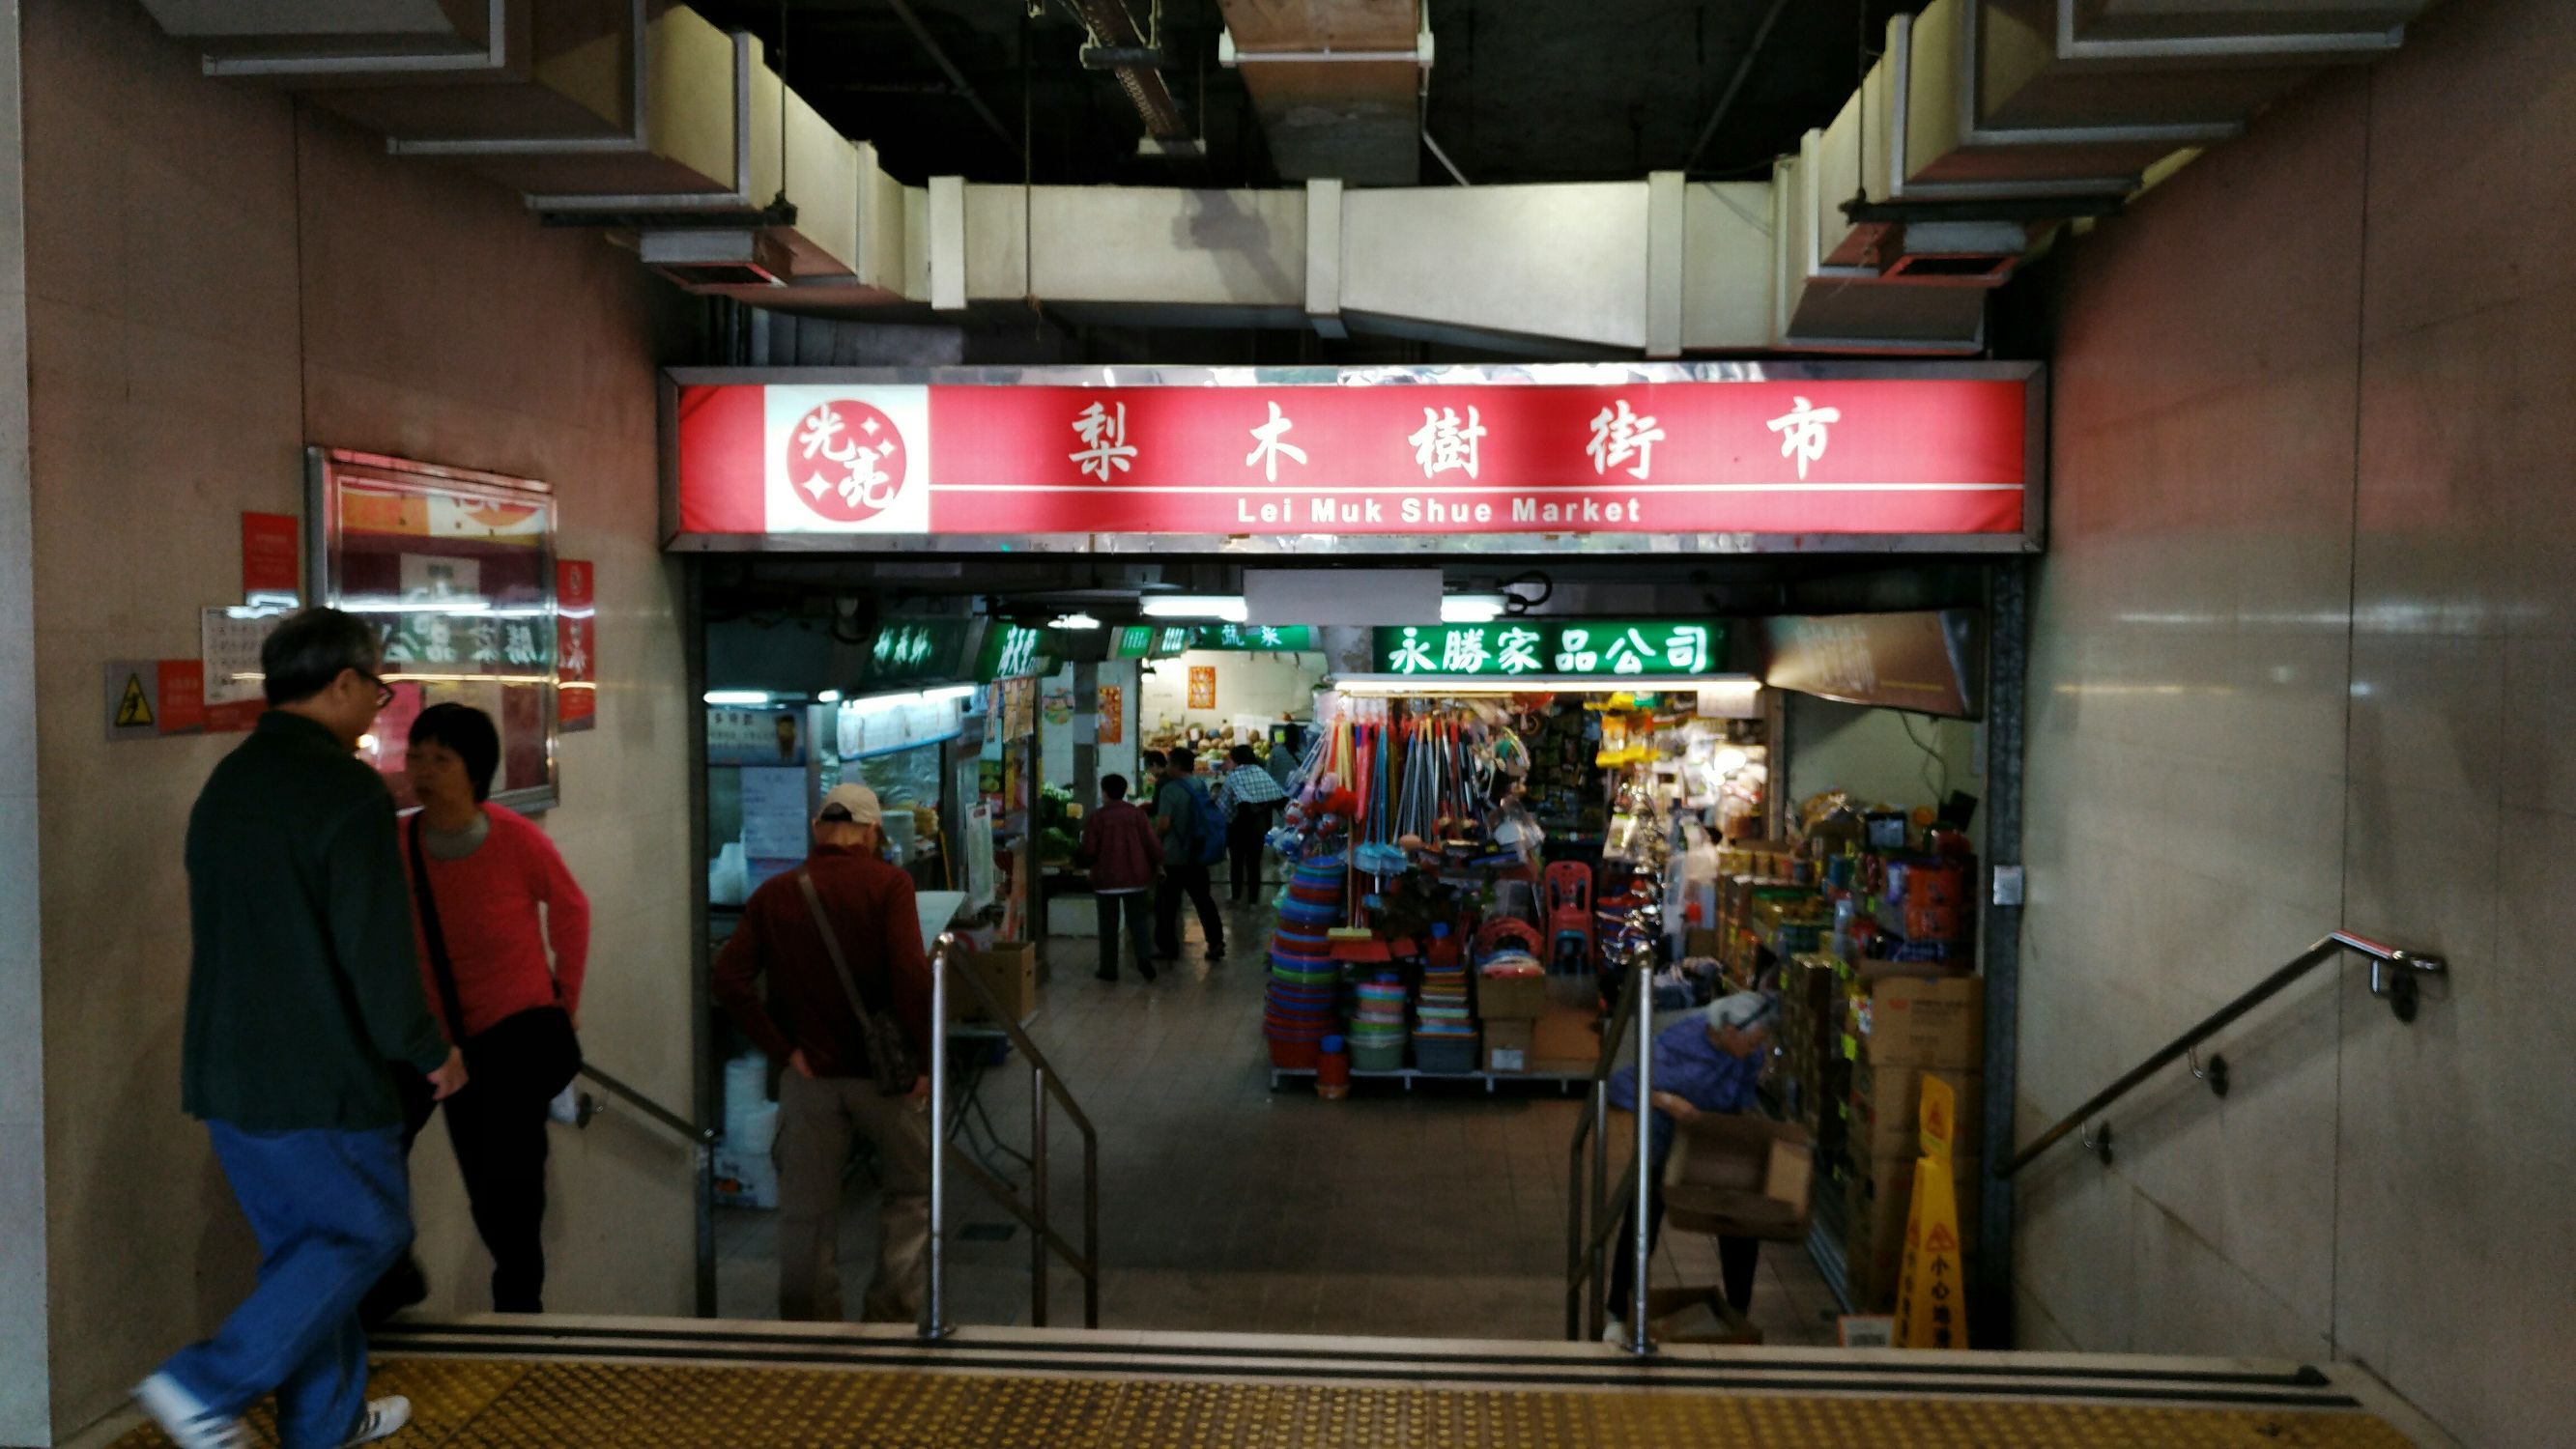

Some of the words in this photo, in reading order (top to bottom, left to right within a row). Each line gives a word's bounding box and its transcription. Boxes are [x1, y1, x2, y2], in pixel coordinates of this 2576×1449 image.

[797, 404, 896, 509] 光亮
[1069, 395, 1842, 483] 梨木樹街市
[1237, 497, 1293, 523] Lei
[1310, 497, 1384, 523] Muk
[1400, 497, 1493, 523] Shue
[1511, 497, 1642, 523] Market
[1388, 625, 1707, 674] 永勝家品公司
